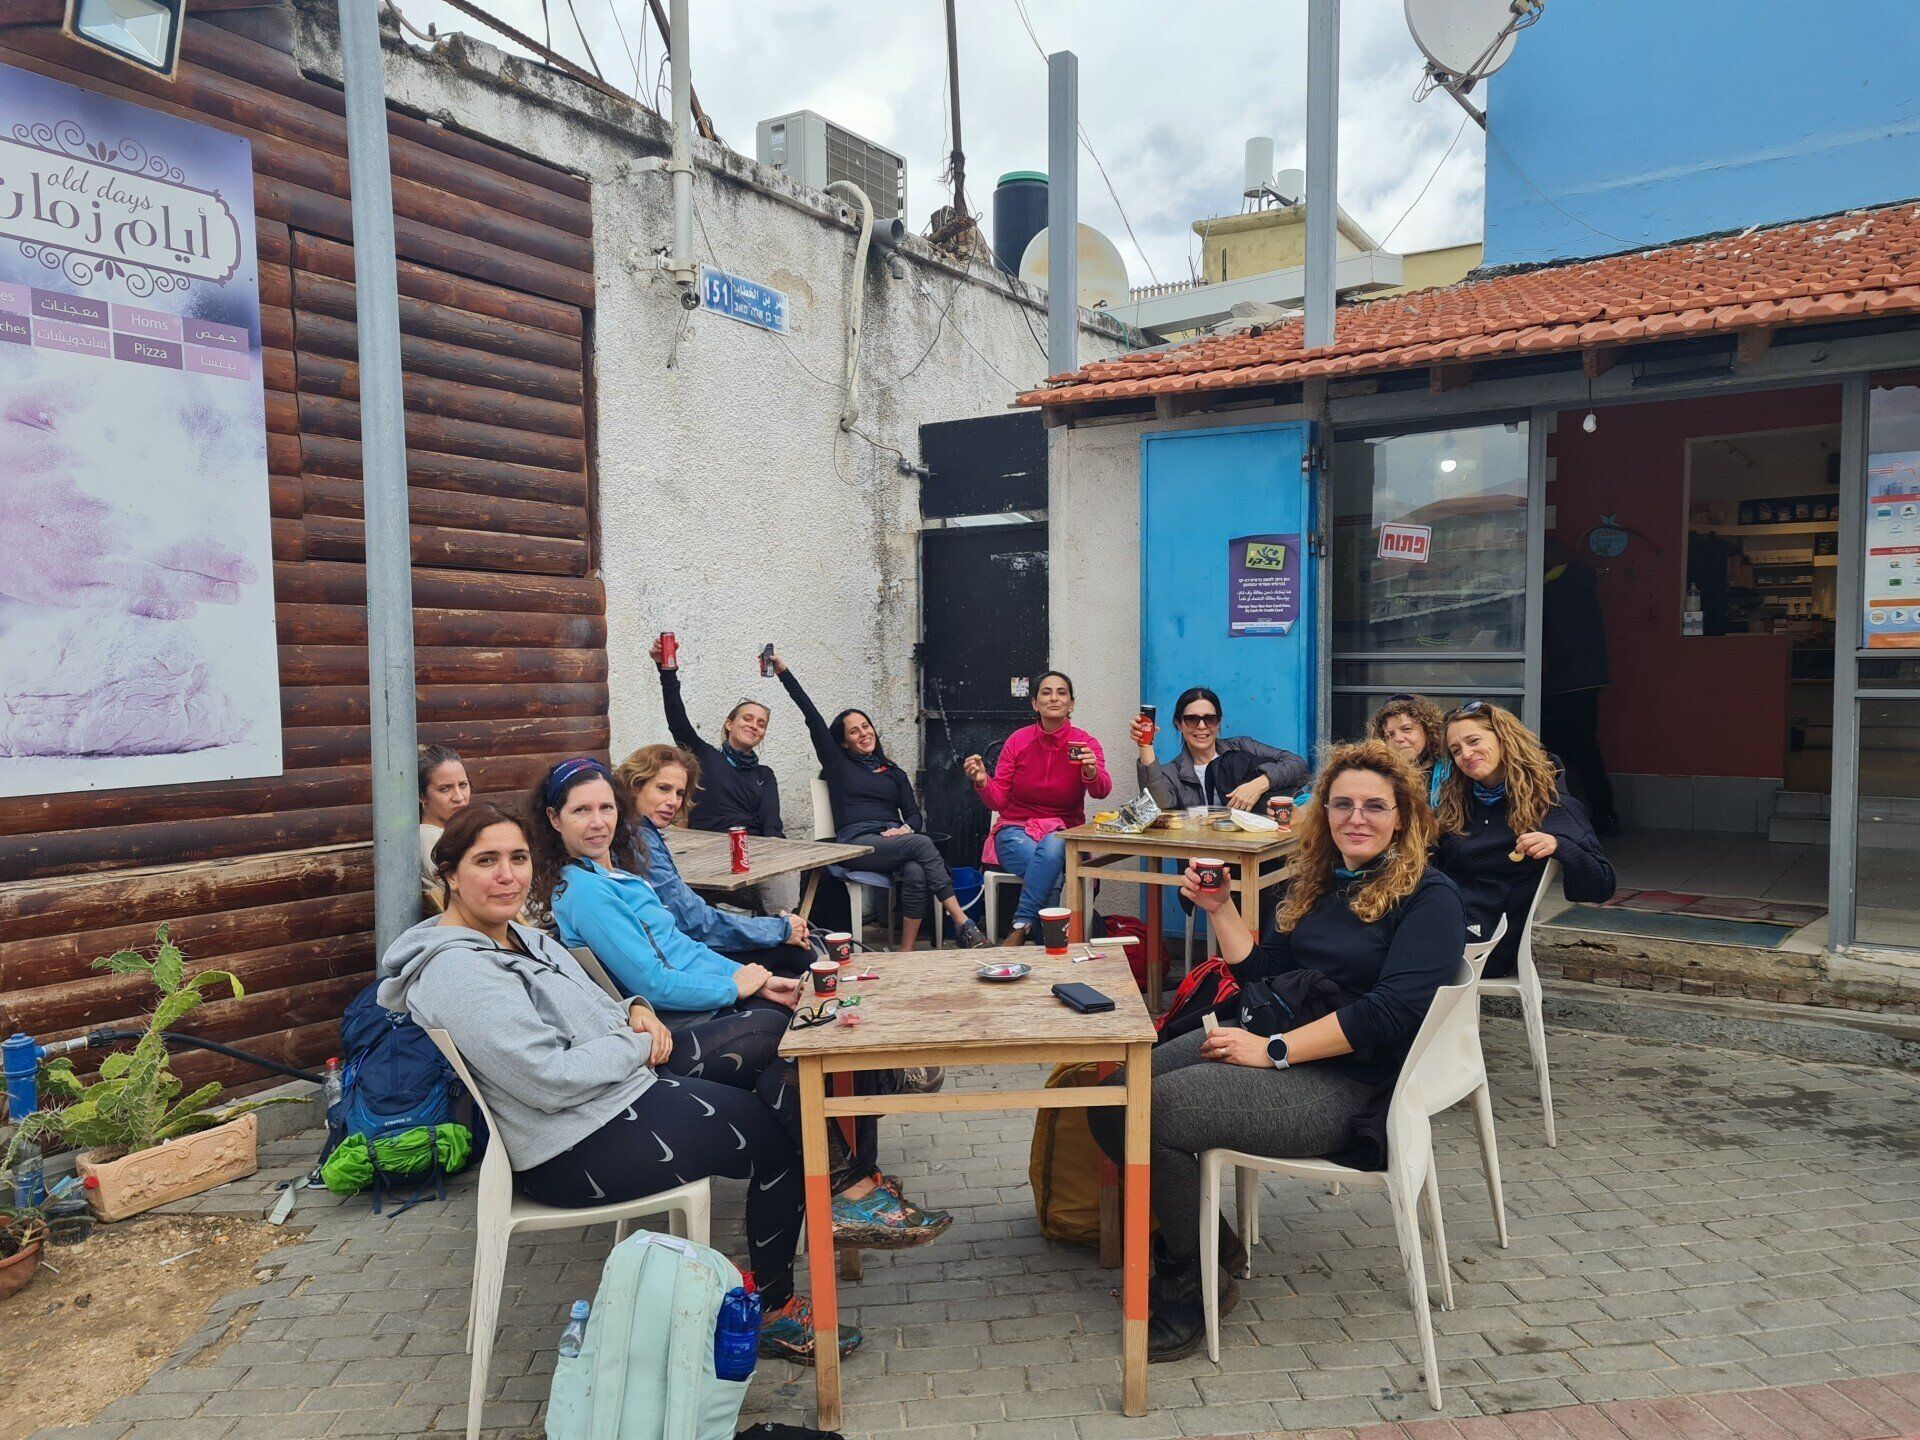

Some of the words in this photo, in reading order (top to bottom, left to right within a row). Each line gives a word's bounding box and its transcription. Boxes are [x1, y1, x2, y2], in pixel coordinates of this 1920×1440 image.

[47, 166, 90, 194] old
[97, 176, 153, 213] days
[114, 205, 212, 264] أيام
[704, 276, 729, 306] 151
[41, 298, 100, 319] معجنات
[130, 313, 169, 331] Homs
[37, 328, 107, 349] ساندويشات
[195, 330, 238, 343] حمص
[133, 342, 168, 359] Pizza
[200, 354, 237, 373] بيتسا
[1384, 533, 1426, 554] פתוח
